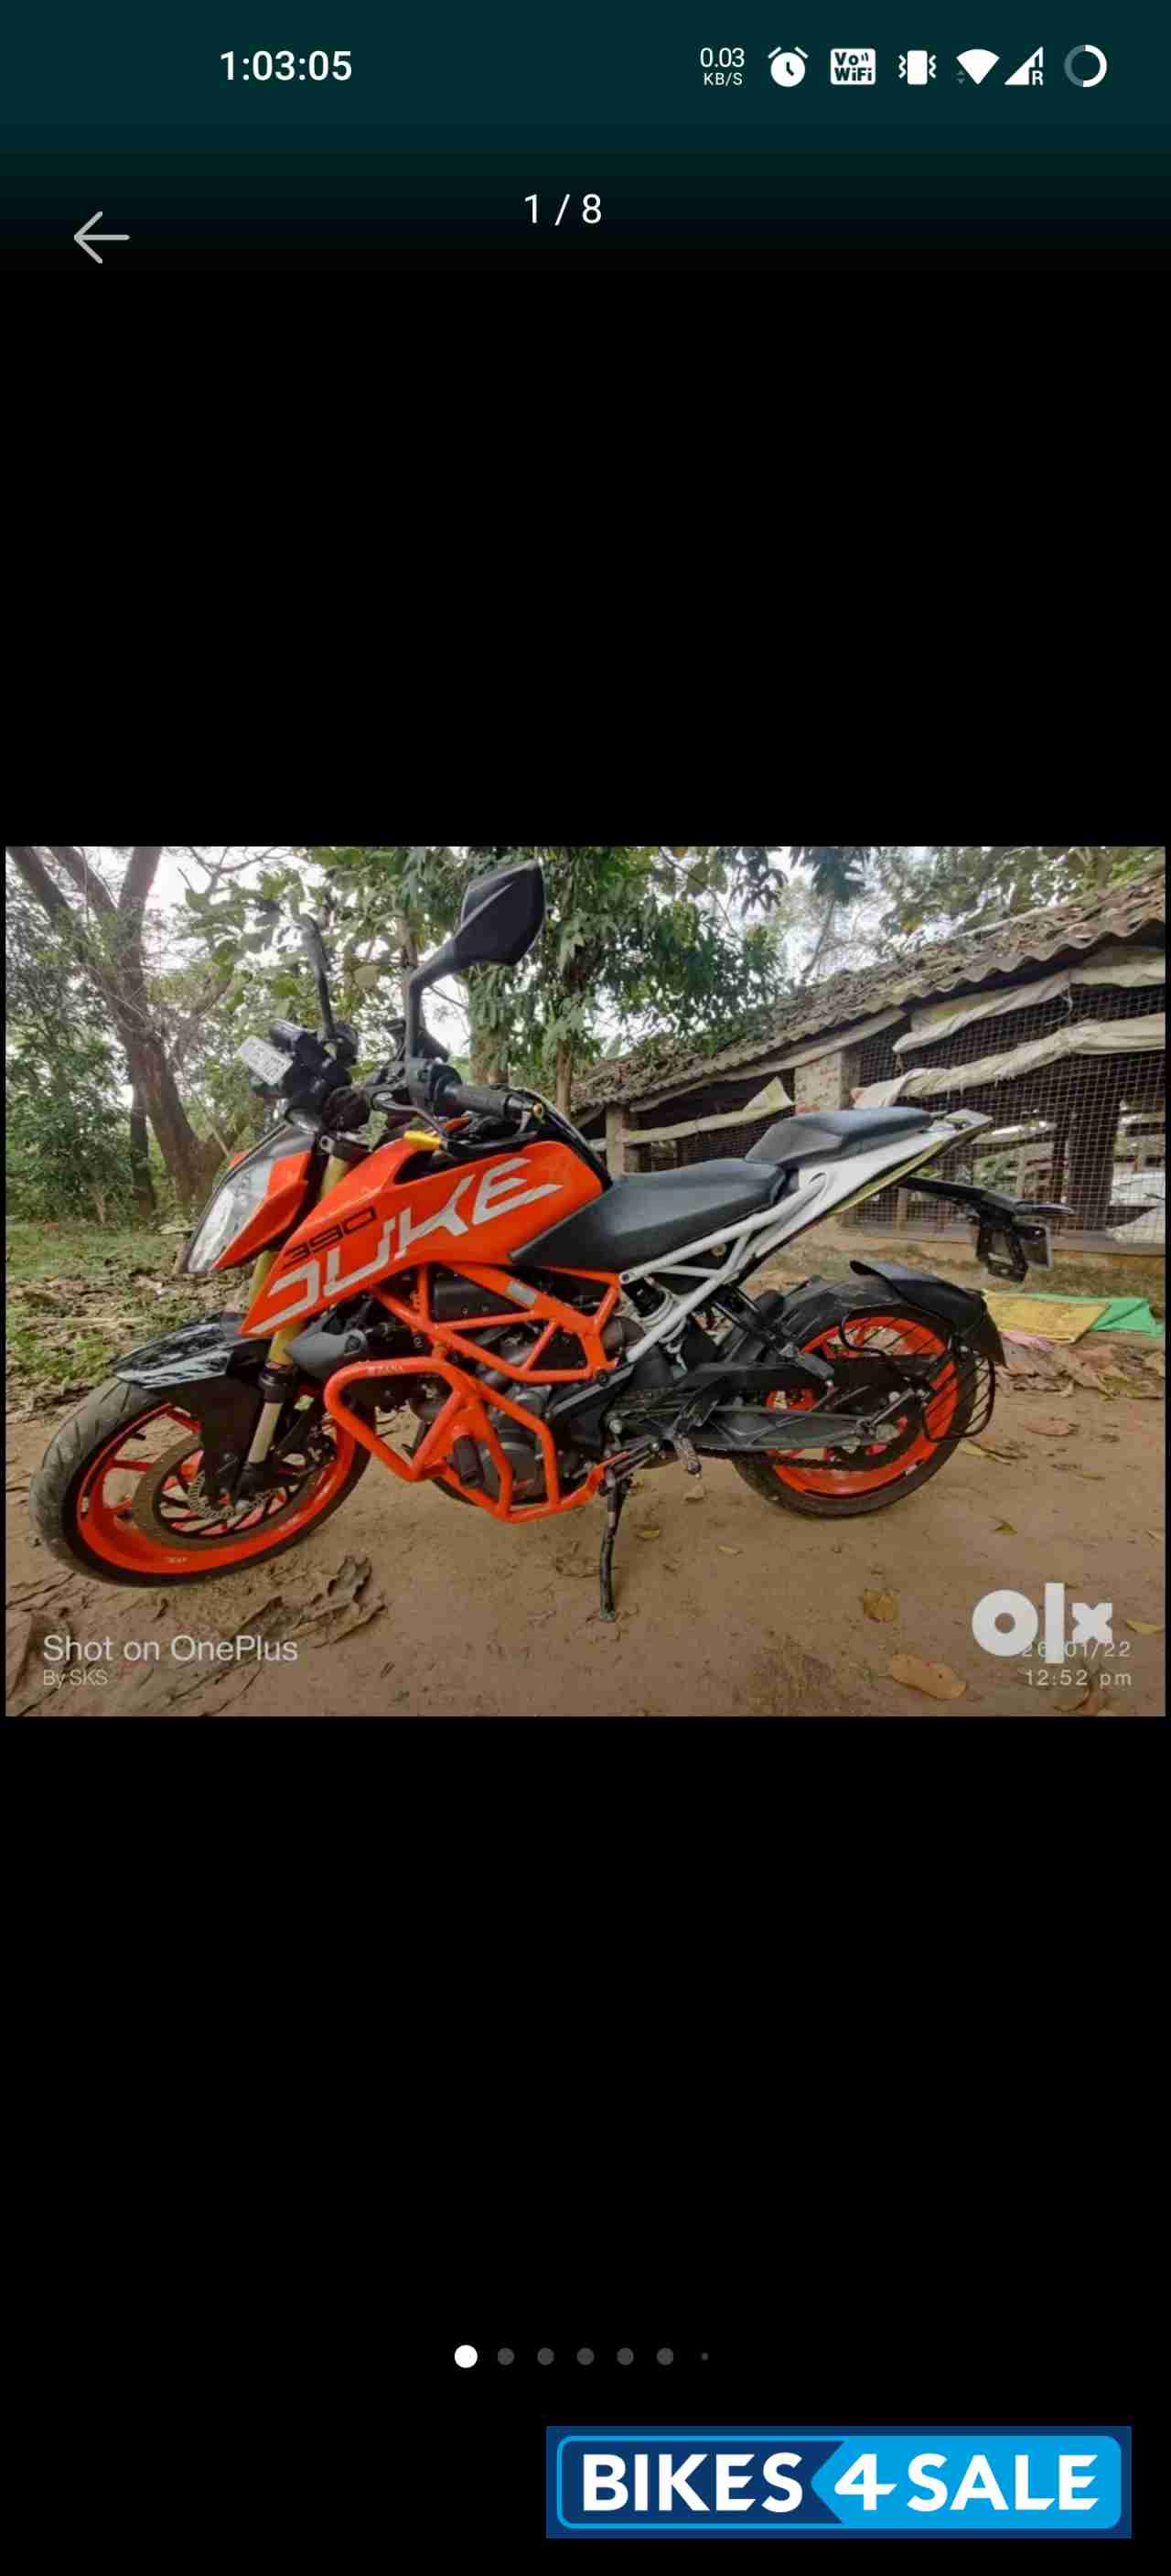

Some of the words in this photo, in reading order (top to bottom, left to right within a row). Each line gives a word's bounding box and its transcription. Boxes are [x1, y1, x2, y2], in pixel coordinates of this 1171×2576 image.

[221, 51, 352, 81] 1:03:05
[699, 47, 746, 69] 0.03
[704, 72, 743, 86] KB/S
[834, 66, 873, 81] WiFi
[1032, 70, 1044, 85] R
[524, 194, 537, 225] 1
[582, 194, 602, 225] 8
[249, 1157, 564, 1334] DUKE
[280, 1206, 377, 1271] 390
